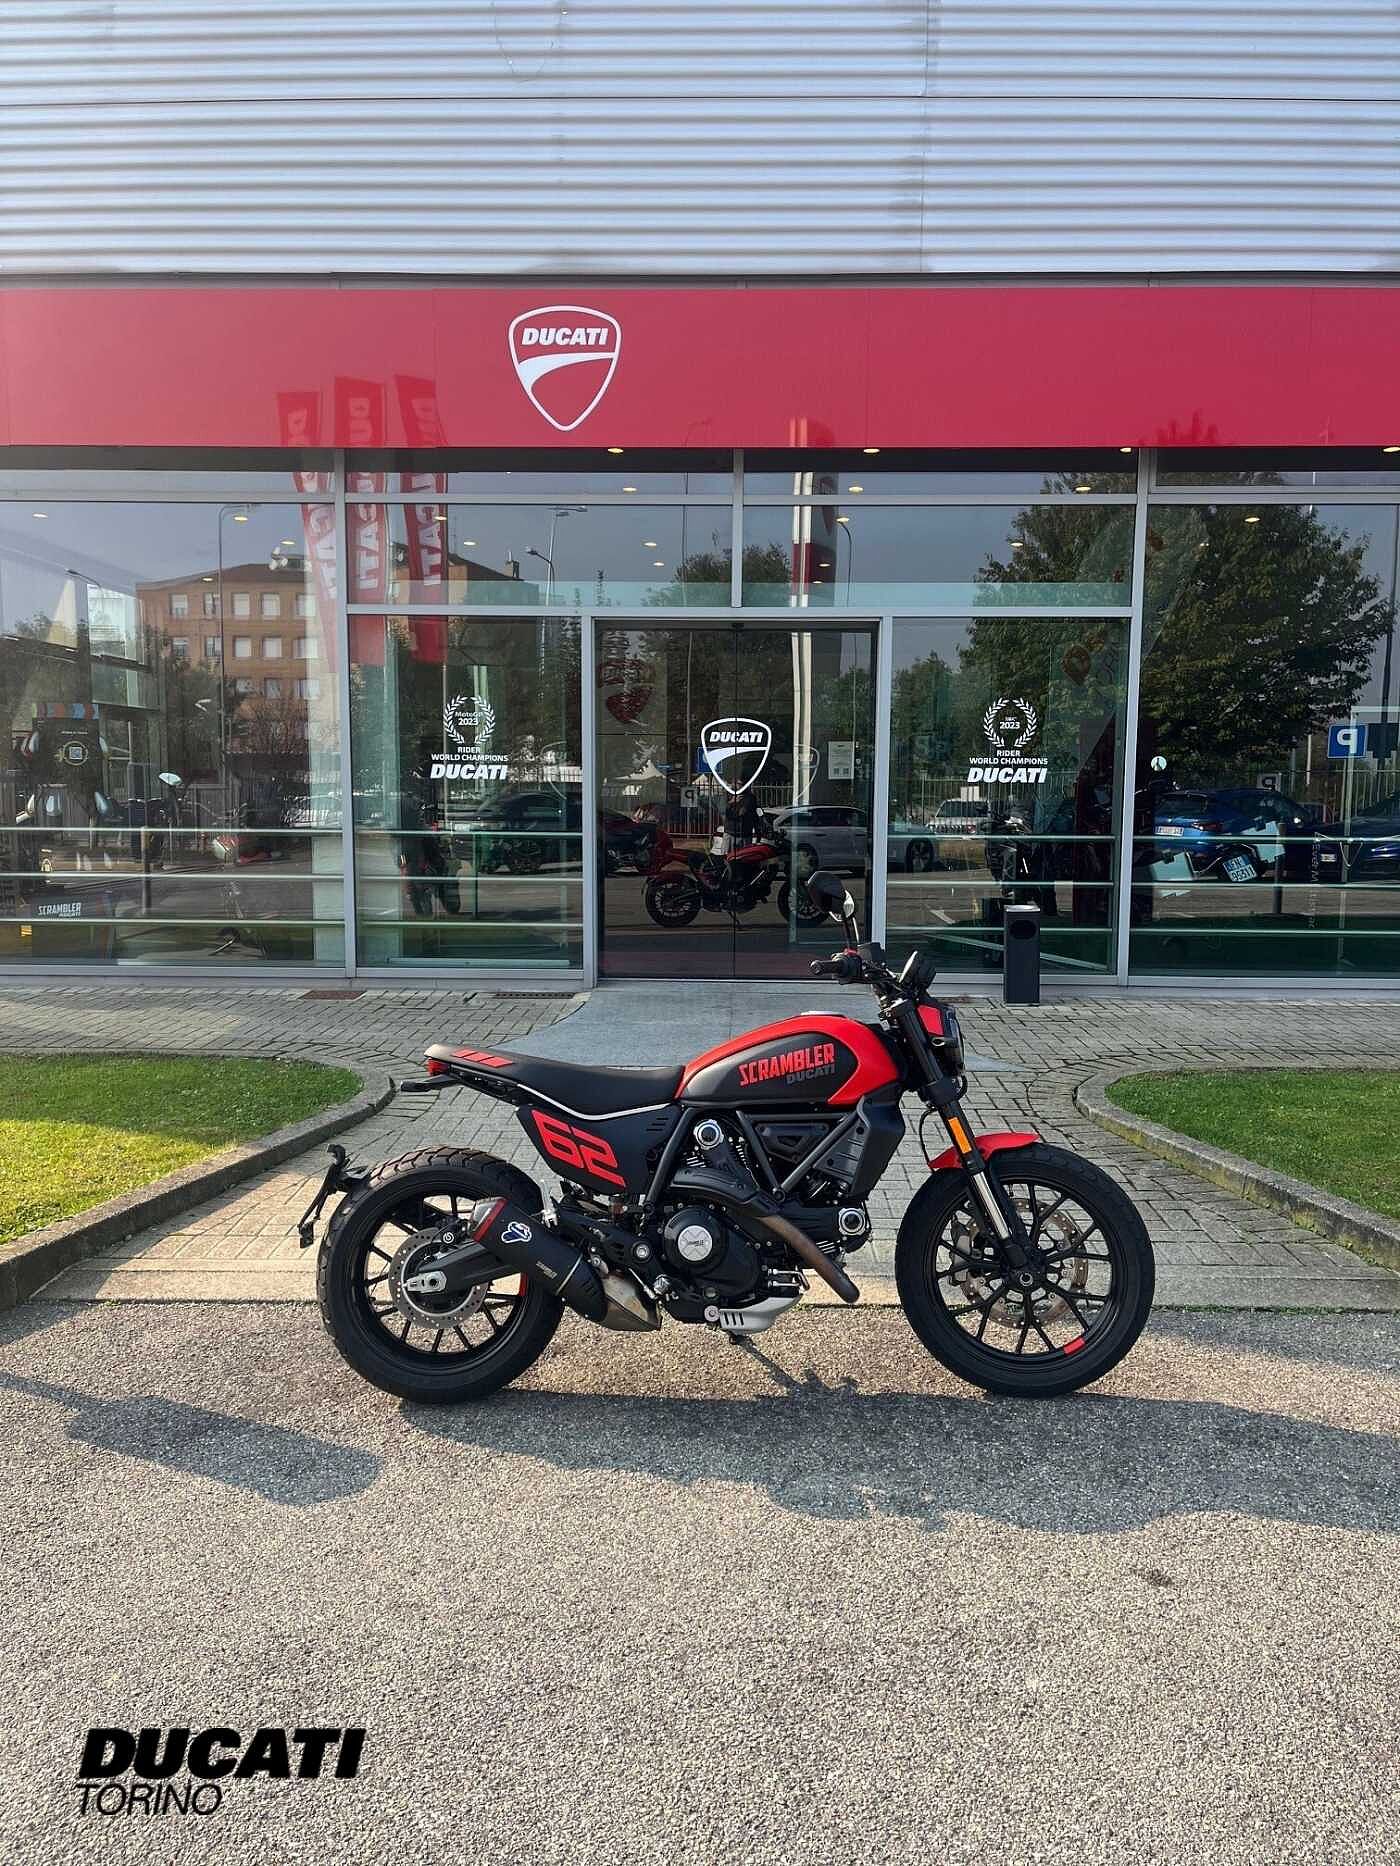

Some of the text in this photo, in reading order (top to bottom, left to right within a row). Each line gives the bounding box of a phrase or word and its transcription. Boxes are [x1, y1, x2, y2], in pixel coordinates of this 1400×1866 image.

[521, 327, 609, 346] DUCATI
[458, 718, 479, 726] 2023
[999, 721, 1021, 730] 2023
[709, 731, 764, 743] DUCATI
[457, 746, 481, 754] RIDER
[996, 749, 1021, 757] RIDER
[431, 753, 508, 762] WORLD CHAMPIONS
[969, 757, 1049, 765] WORLD CHAMPIONS
[430, 763, 508, 779] DUCATI
[967, 767, 1048, 783] DUCATI
[738, 1042, 835, 1086] SCRAMBLER
[786, 1063, 836, 1085] DUCATI
[531, 1109, 626, 1188] 62
